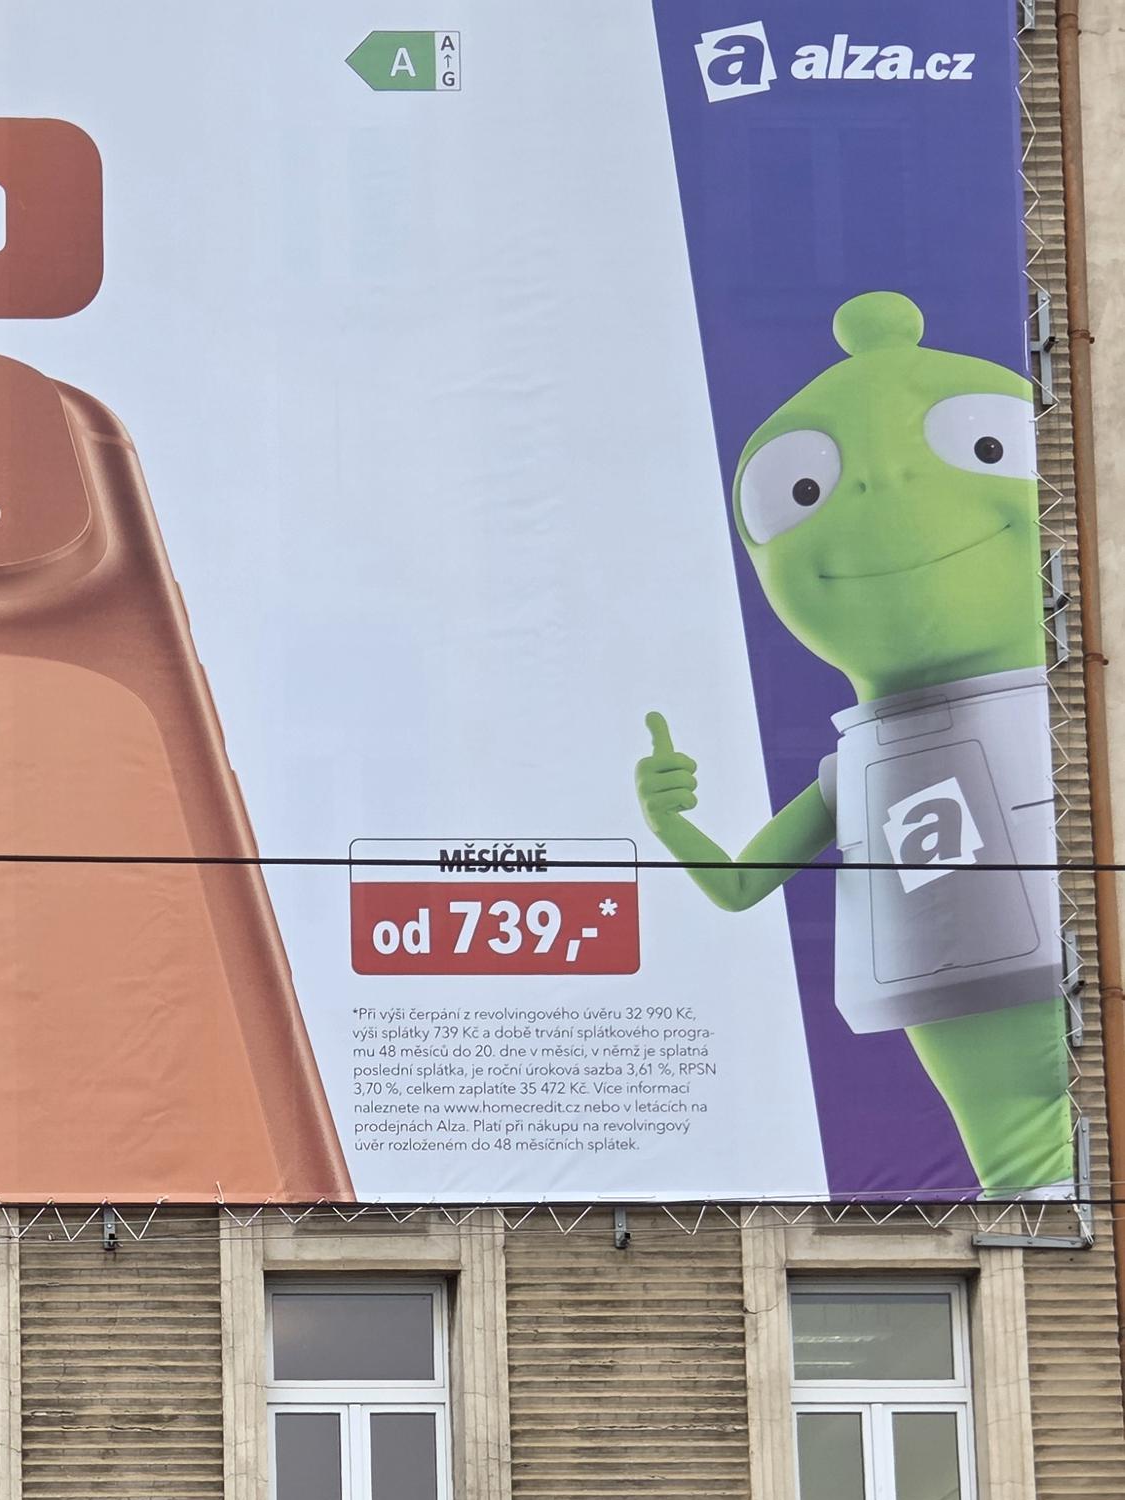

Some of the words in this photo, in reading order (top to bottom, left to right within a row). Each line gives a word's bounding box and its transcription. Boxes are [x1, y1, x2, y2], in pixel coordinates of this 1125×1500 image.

[440, 36, 455, 51] A
[790, 33, 975, 82] alza.cz
[389, 46, 416, 77] A
[441, 71, 455, 87] G
[439, 842, 549, 873] MĚSÍČNĚ
[373, 907, 431, 955] od
